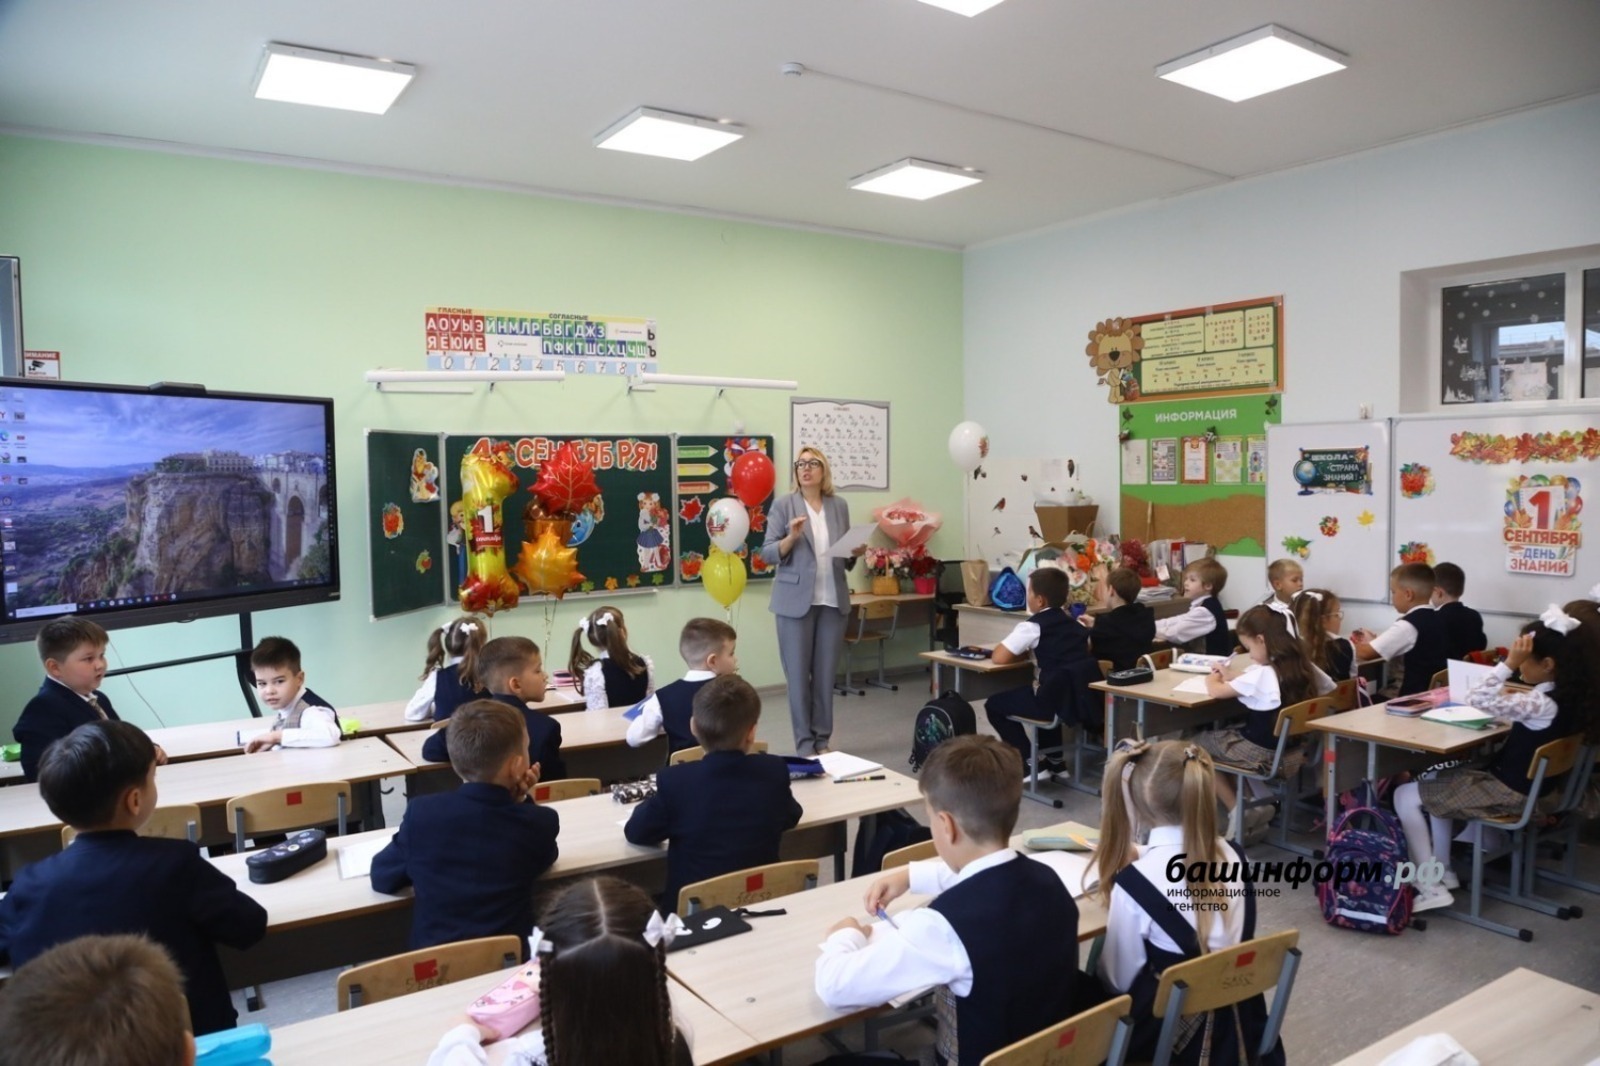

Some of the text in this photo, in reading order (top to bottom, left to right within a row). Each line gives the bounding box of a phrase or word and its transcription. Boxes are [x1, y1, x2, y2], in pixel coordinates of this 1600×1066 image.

[548, 313, 589, 321] СОГЛАСНЫЕ
[1155, 409, 1237, 423] ИНФОРМАЦИЯ
[1329, 464, 1360, 472] СТРАНА
[1528, 491, 1550, 529] 1
[477, 505, 494, 533] 1
[1504, 530, 1578, 545] СЕНТЯБРЯ
[1523, 548, 1556, 559] ДЕНЬ
[1510, 558, 1568, 573] ЗНАНИЙ
